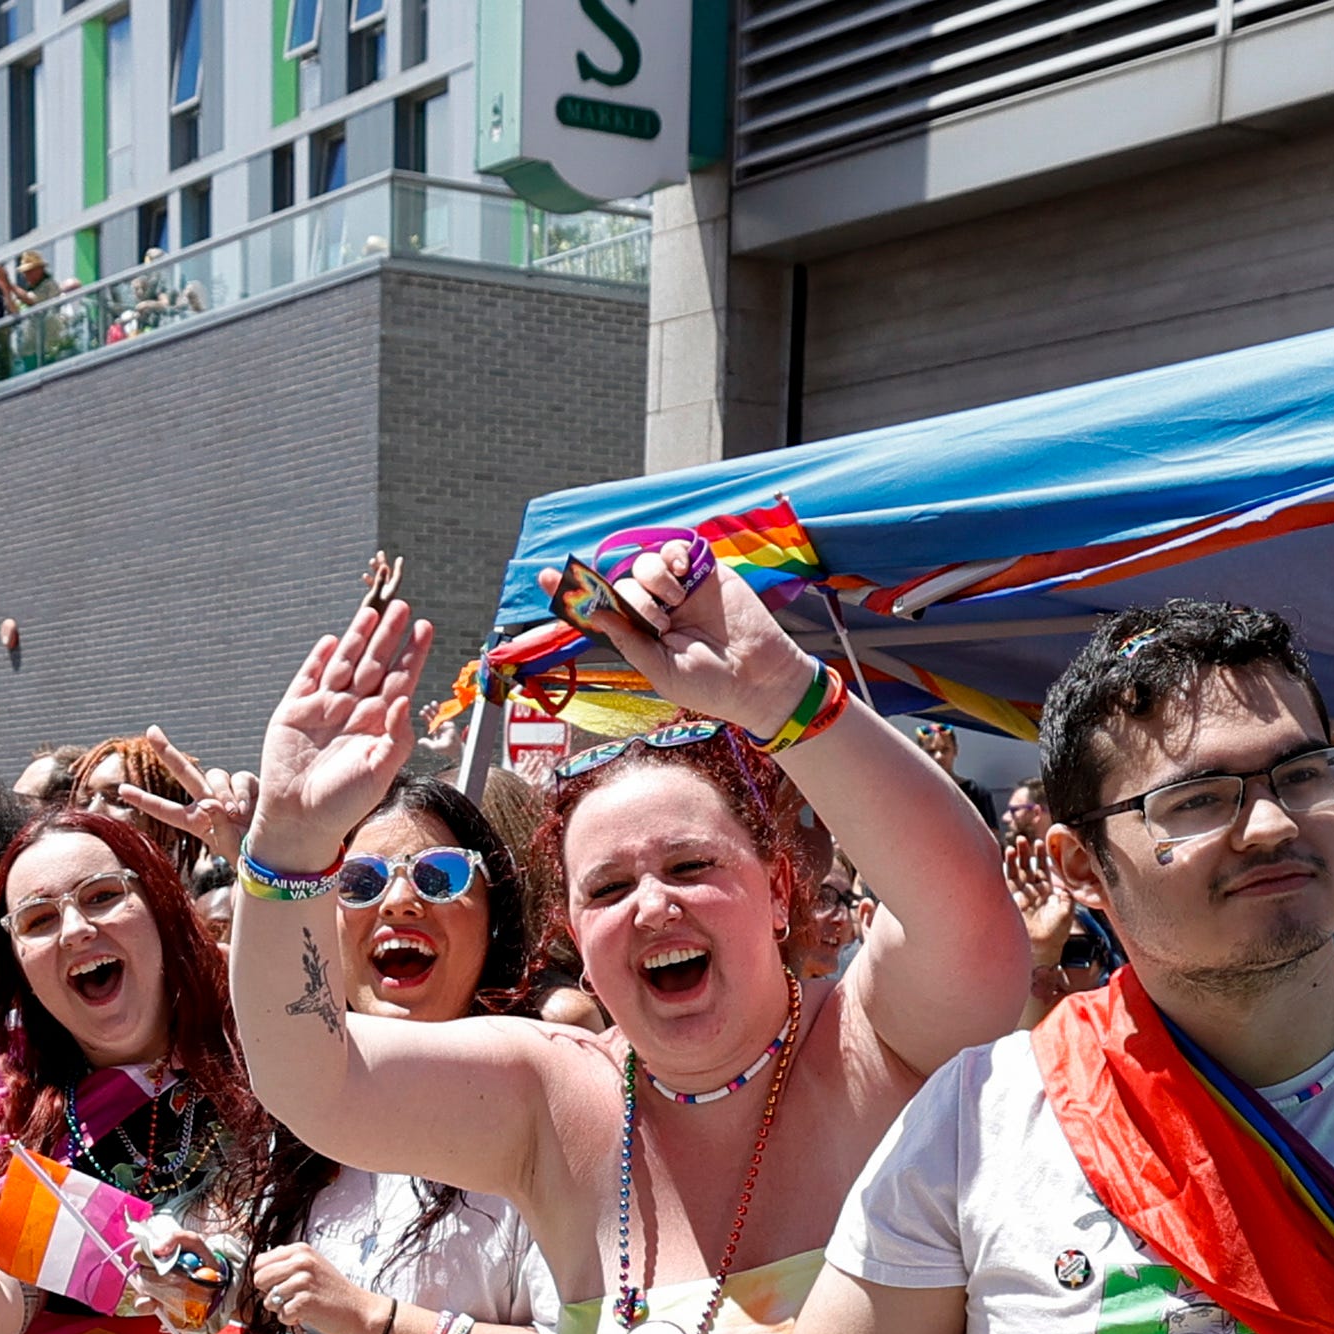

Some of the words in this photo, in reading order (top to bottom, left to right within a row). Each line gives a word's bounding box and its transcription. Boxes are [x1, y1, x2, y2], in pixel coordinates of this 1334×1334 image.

[271, 879, 287, 889] All
[289, 880, 318, 890] Who
[289, 890, 308, 900] VA
